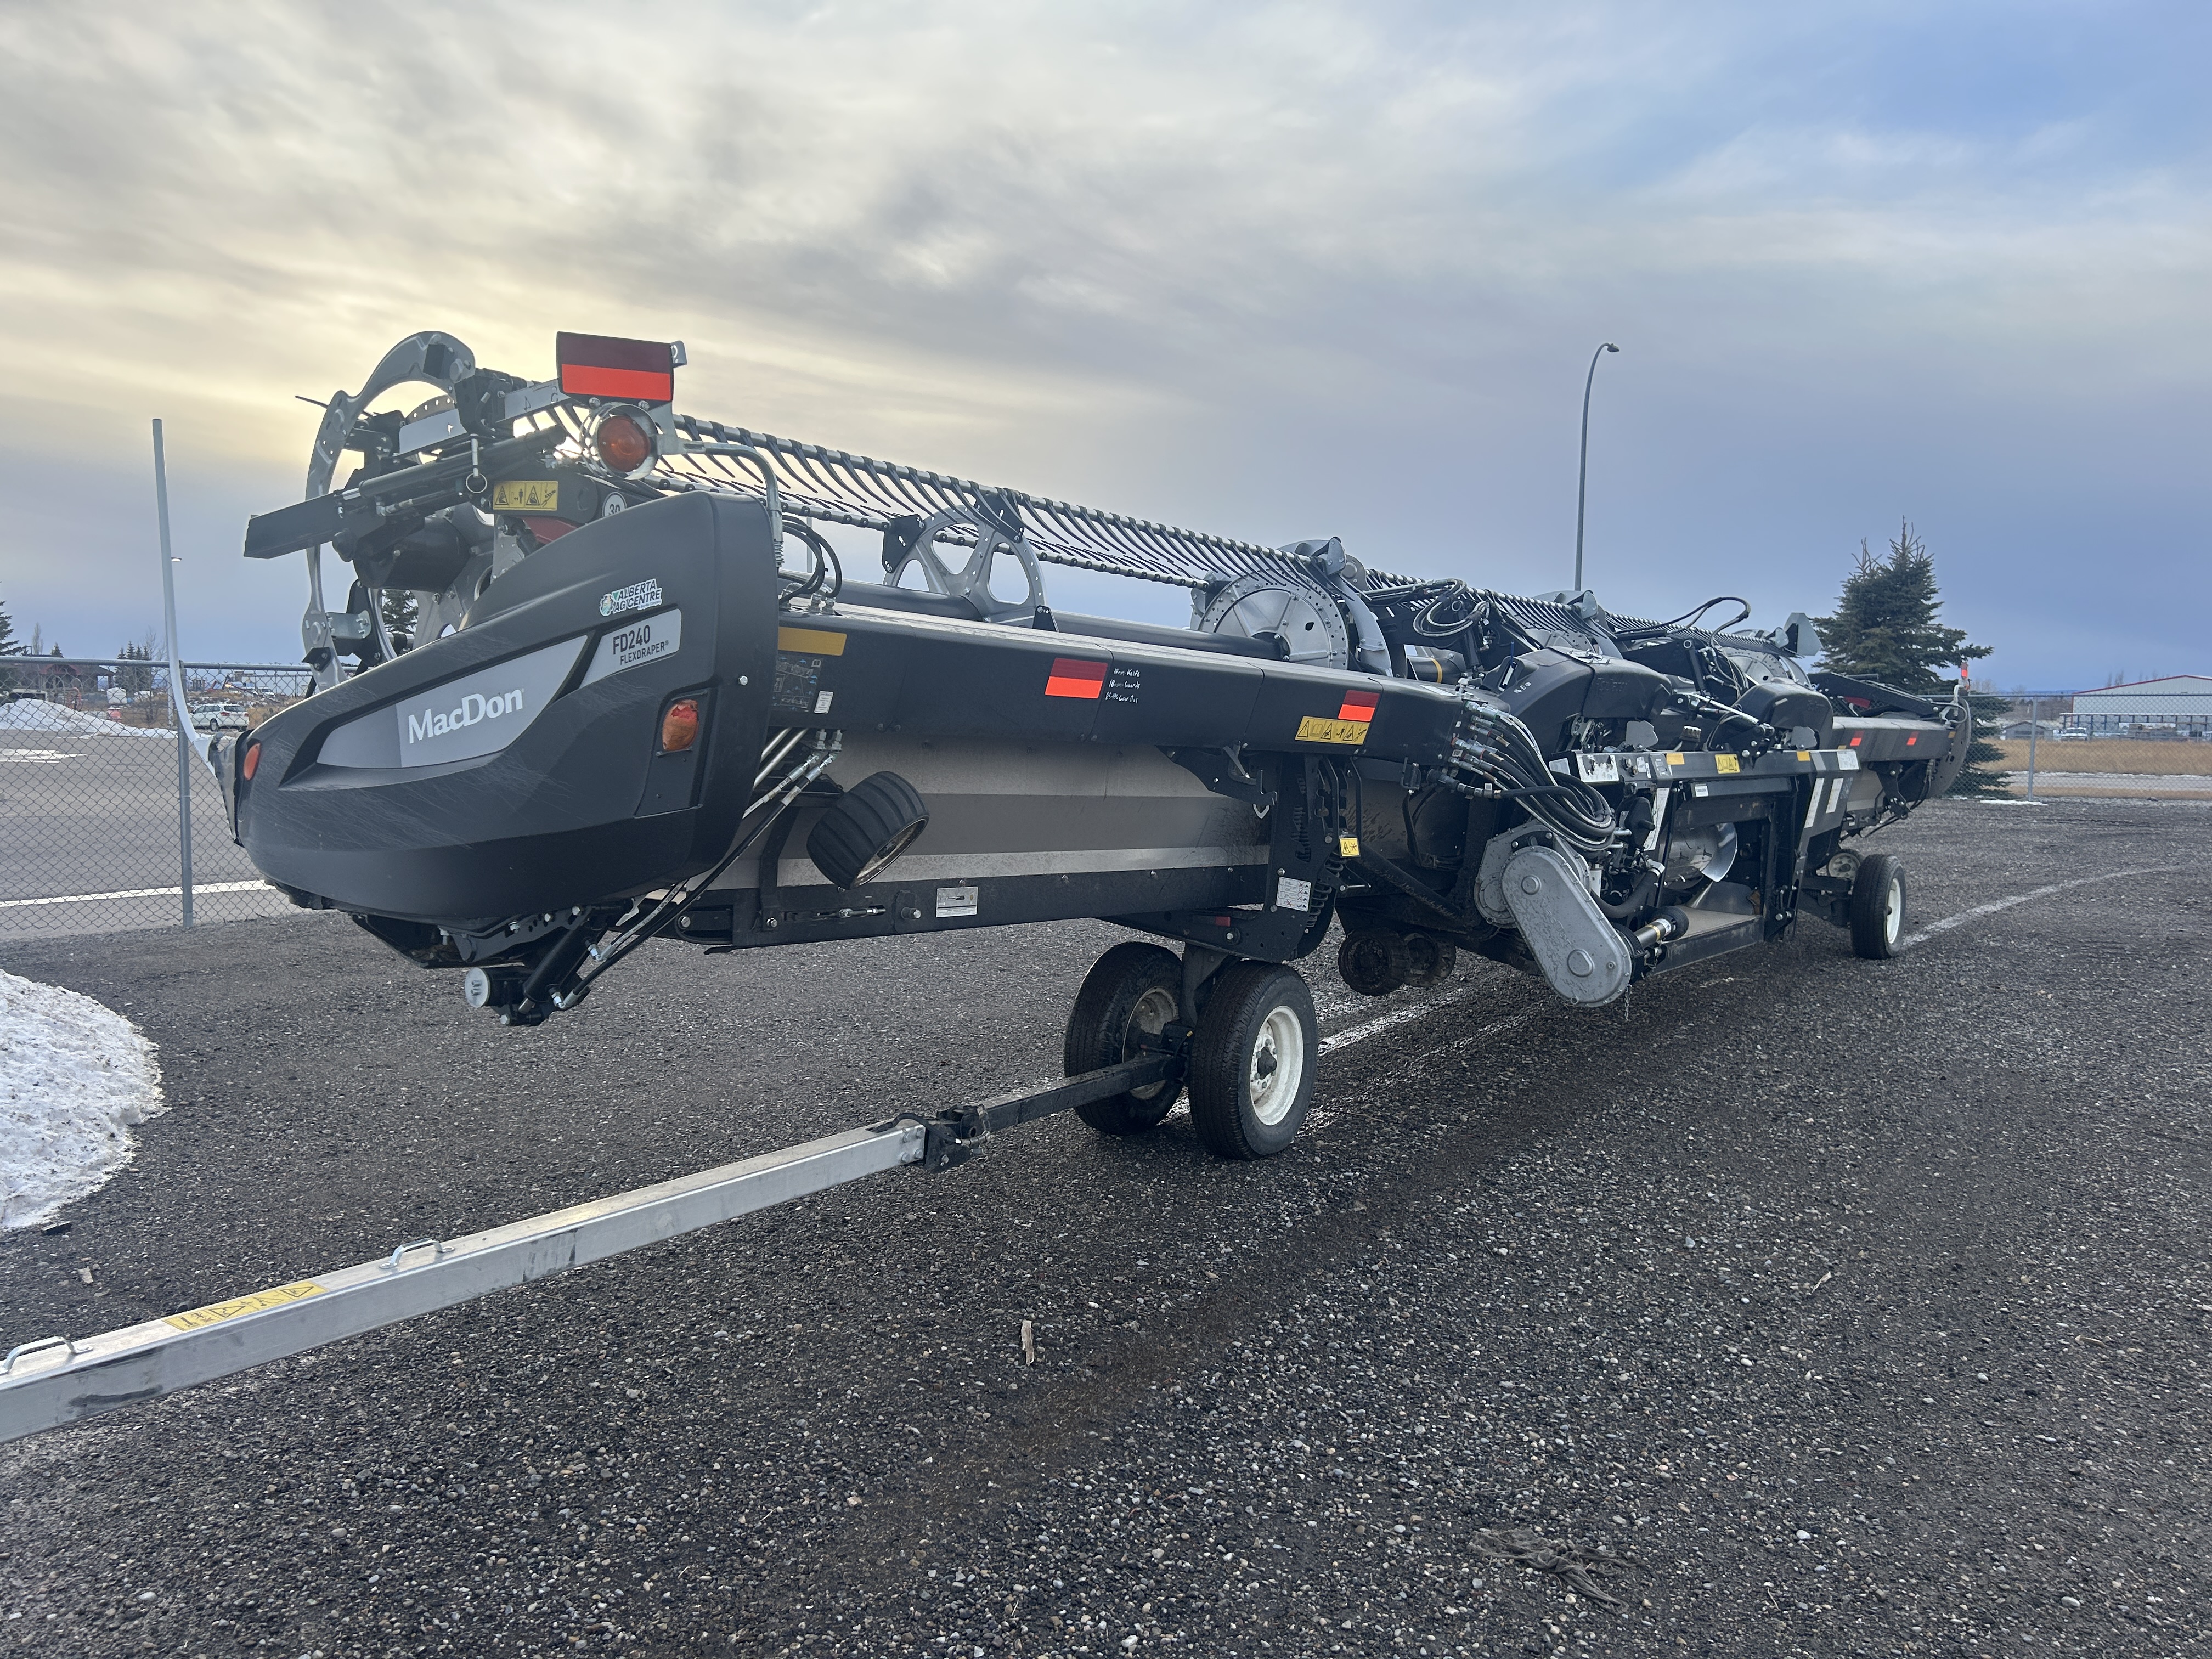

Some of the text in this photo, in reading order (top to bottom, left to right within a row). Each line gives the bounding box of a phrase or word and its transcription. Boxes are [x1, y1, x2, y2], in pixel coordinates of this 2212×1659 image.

[618, 579, 656, 601] ALBERTA
[628, 589, 661, 609] CENTRE
[613, 624, 651, 655] FD240
[1129, 695, 1138, 704] Box
[408, 689, 523, 744] MacDon
